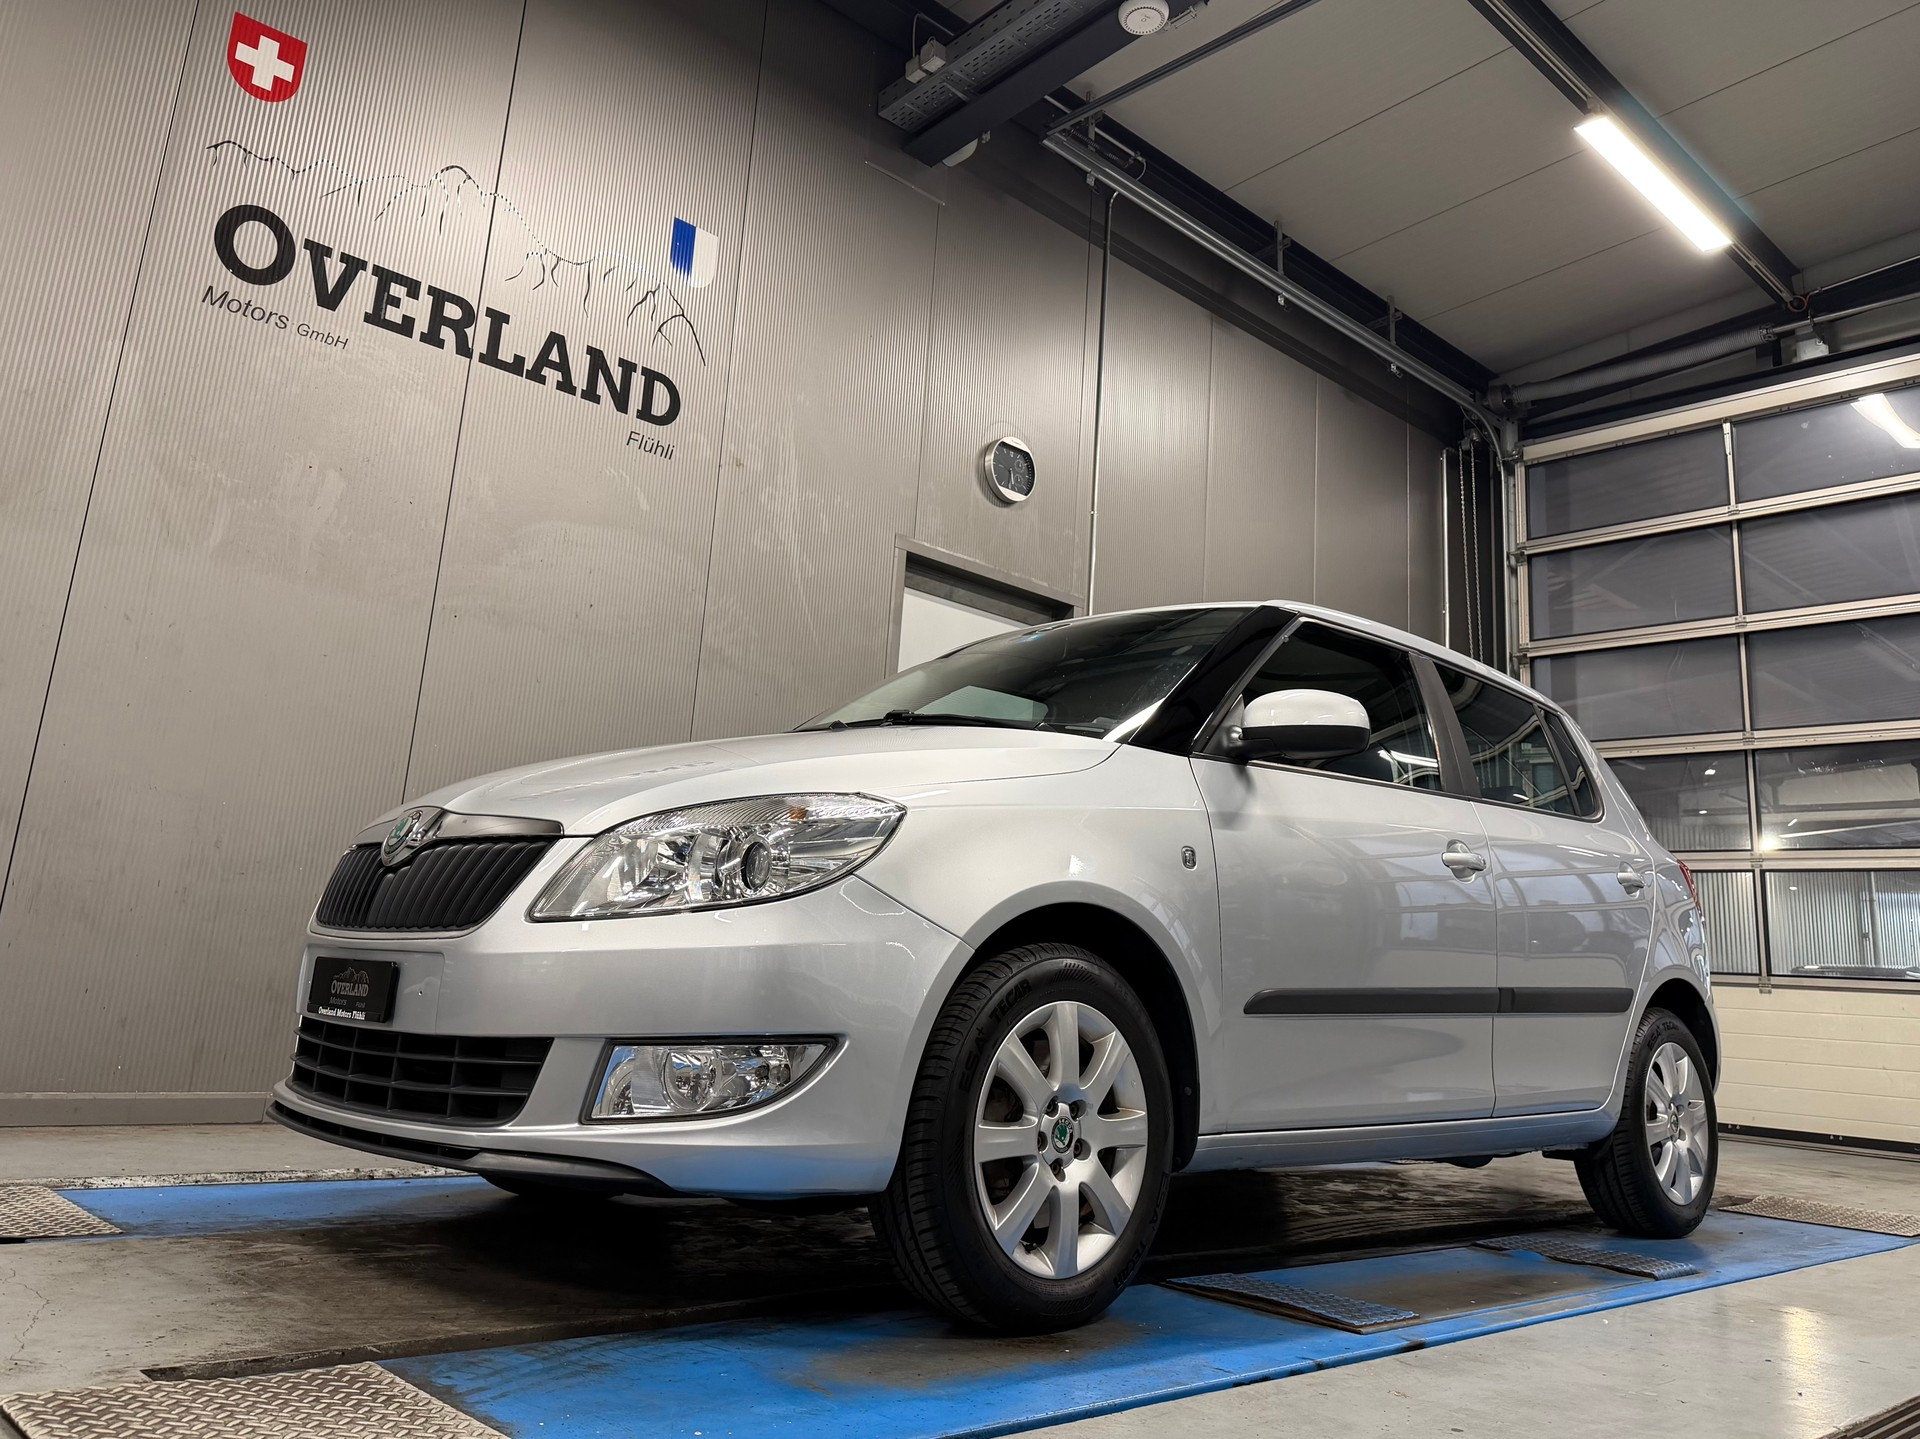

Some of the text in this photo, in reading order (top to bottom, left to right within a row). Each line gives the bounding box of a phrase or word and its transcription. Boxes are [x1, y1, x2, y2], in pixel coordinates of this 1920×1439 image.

[201, 284, 349, 350] Motors GmbH
[213, 204, 682, 427] OVERLAND
[626, 430, 675, 461] Flühli
[331, 980, 368, 996] OVERLAND
[988, 979, 1033, 1024] TECAR
[318, 1006, 336, 1017] Overland
[337, 1009, 351, 1018] Motors
